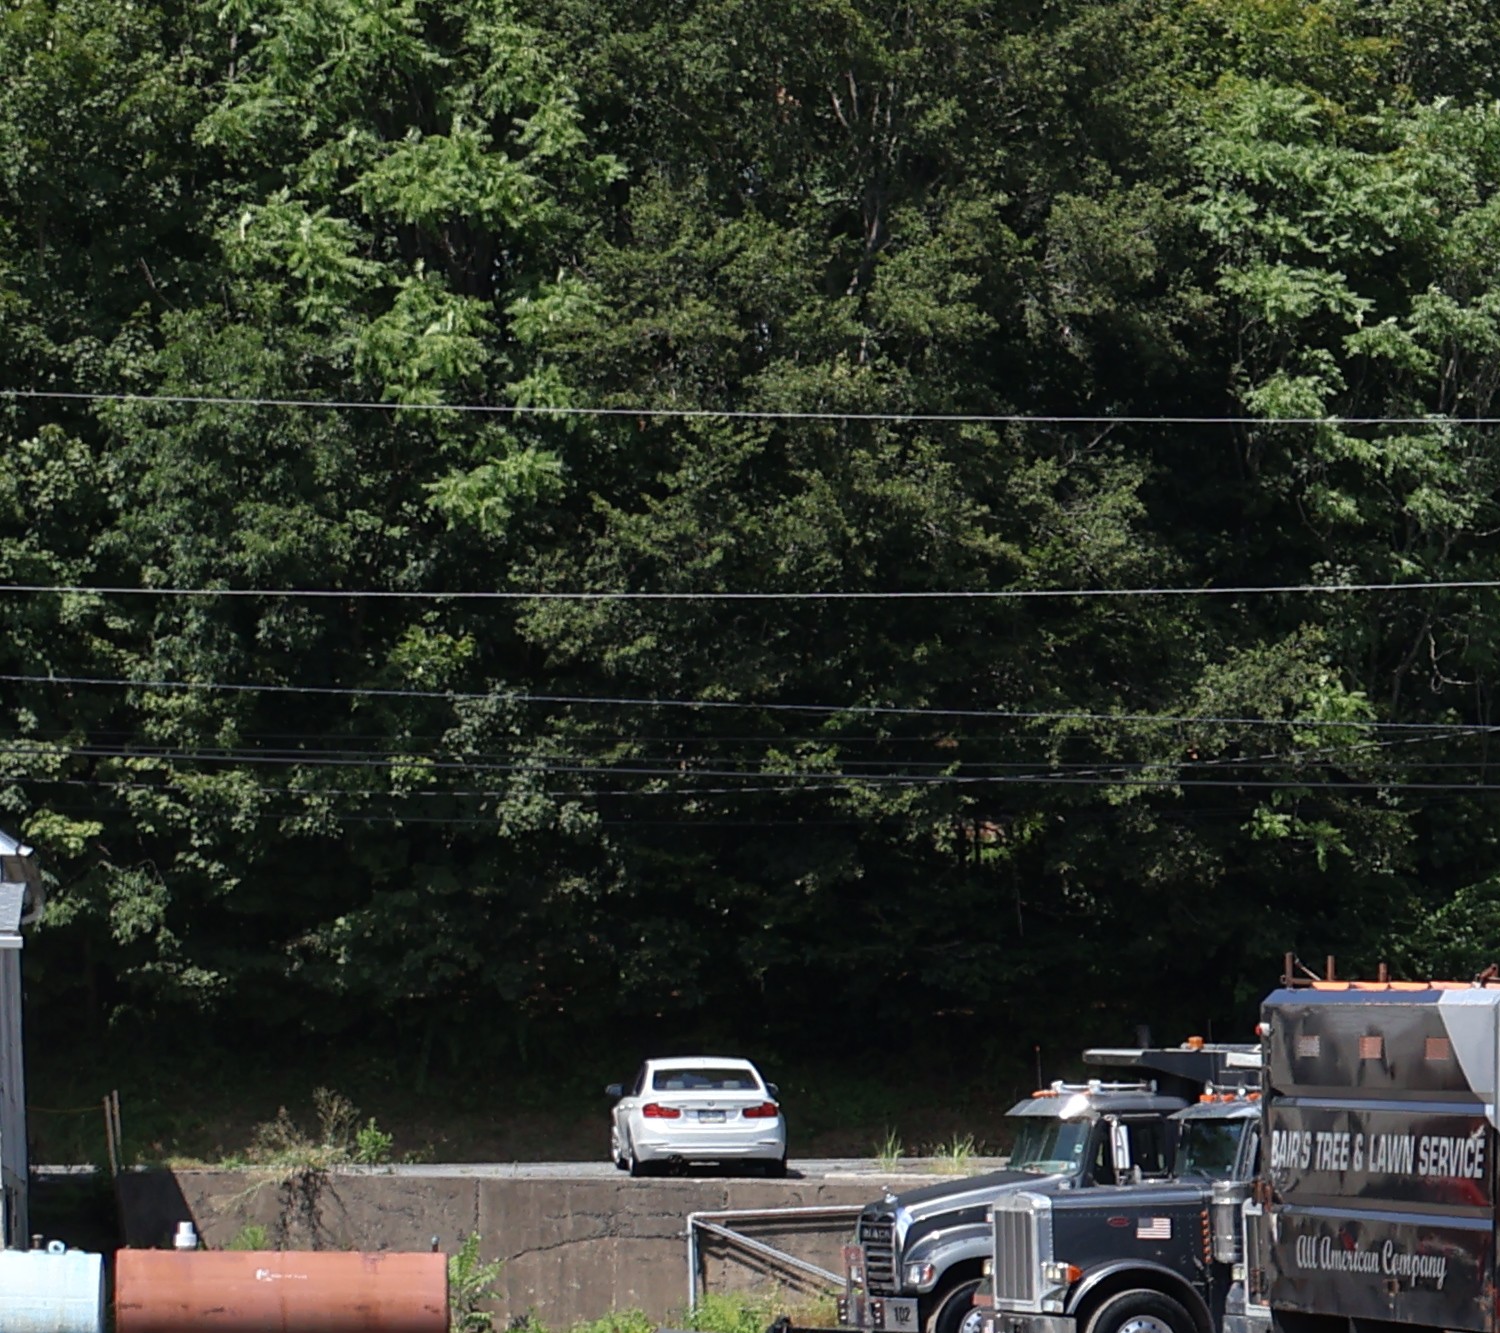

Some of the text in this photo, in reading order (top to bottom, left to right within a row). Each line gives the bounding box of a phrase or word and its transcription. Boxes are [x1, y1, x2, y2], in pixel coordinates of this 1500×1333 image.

[1270, 1130, 1485, 1179] BAIR'S TREE & LAWN SERVICE
[1296, 1234, 1448, 1291] All American Company
[893, 1305, 911, 1323] 102
